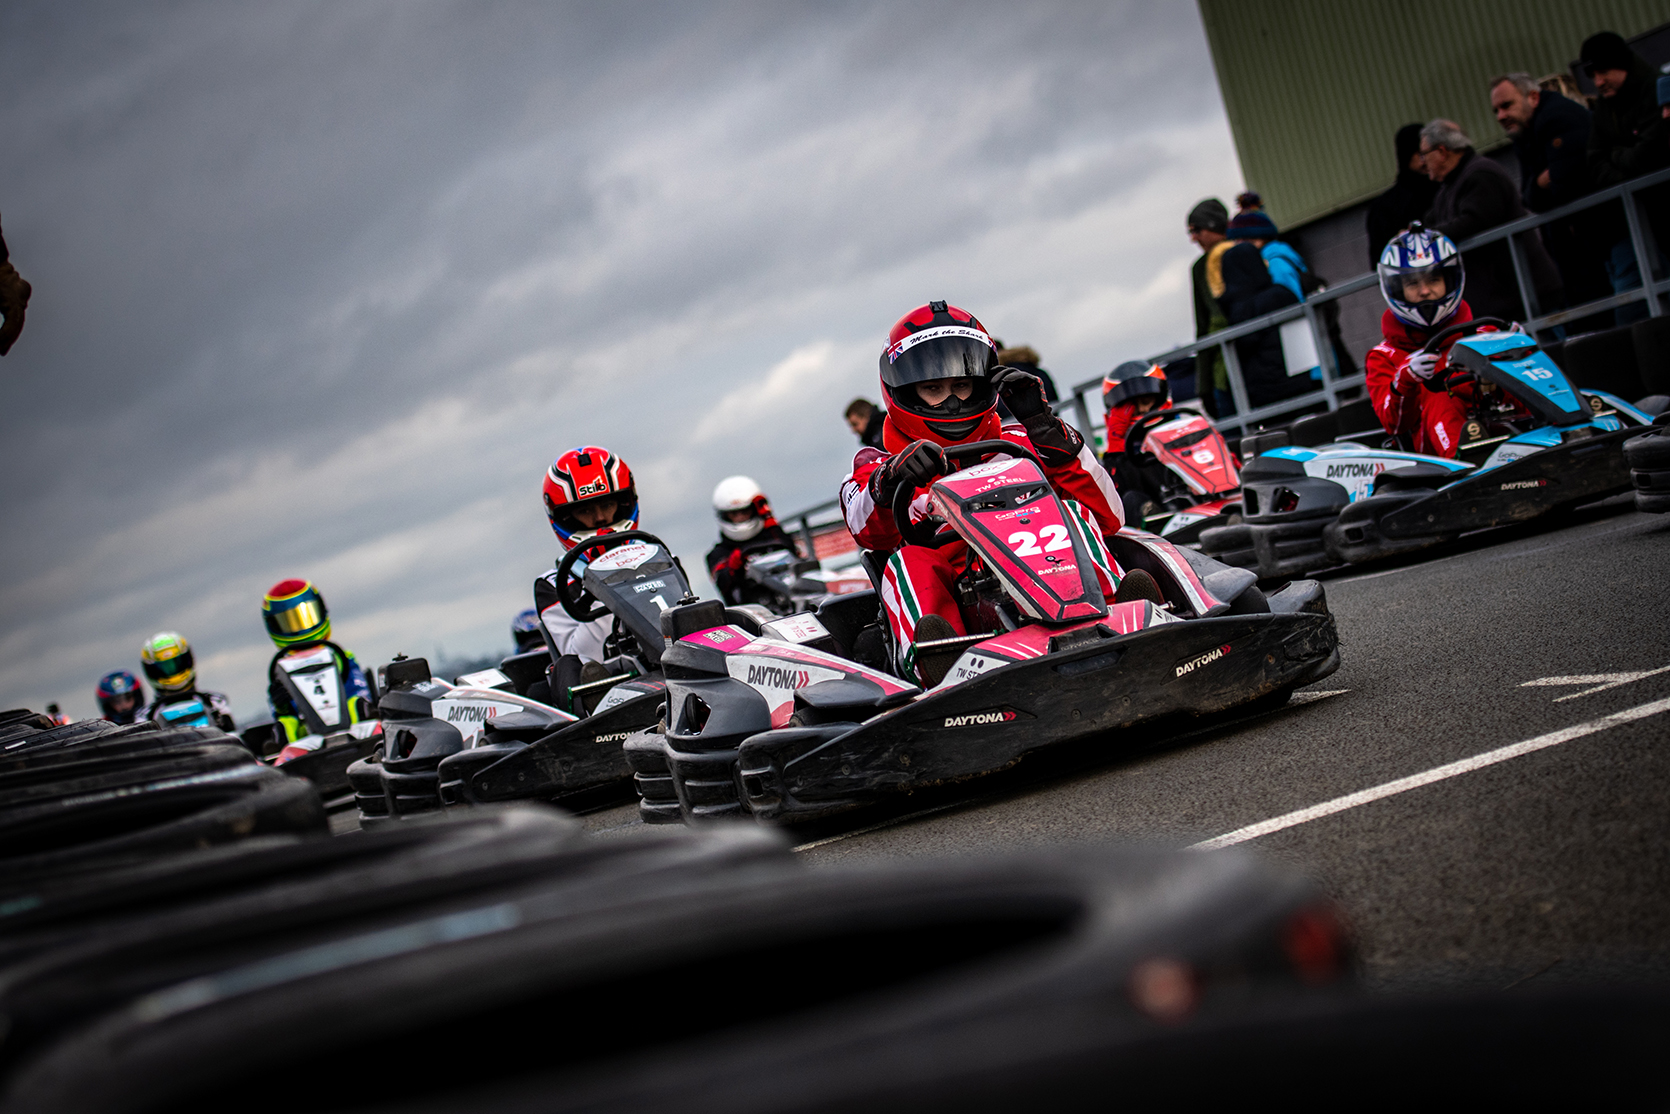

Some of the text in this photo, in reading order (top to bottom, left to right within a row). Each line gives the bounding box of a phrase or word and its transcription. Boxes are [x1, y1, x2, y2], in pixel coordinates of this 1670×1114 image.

[910, 331, 939, 345] Mark
[1521, 367, 1554, 381] 15
[1326, 463, 1374, 478] DAYTONA
[975, 477, 1027, 493] TW STEEL
[1501, 480, 1539, 490] DAYTONA
[1008, 524, 1073, 557] 22
[599, 545, 647, 563] claranet
[1038, 564, 1077, 575] DAYTONA
[1176, 648, 1223, 677] DAYTONA
[747, 664, 797, 690] DAYTONA
[956, 667, 968, 679] TW
[447, 706, 488, 722] DAYTONA
[944, 712, 1004, 727] DAYTONA
